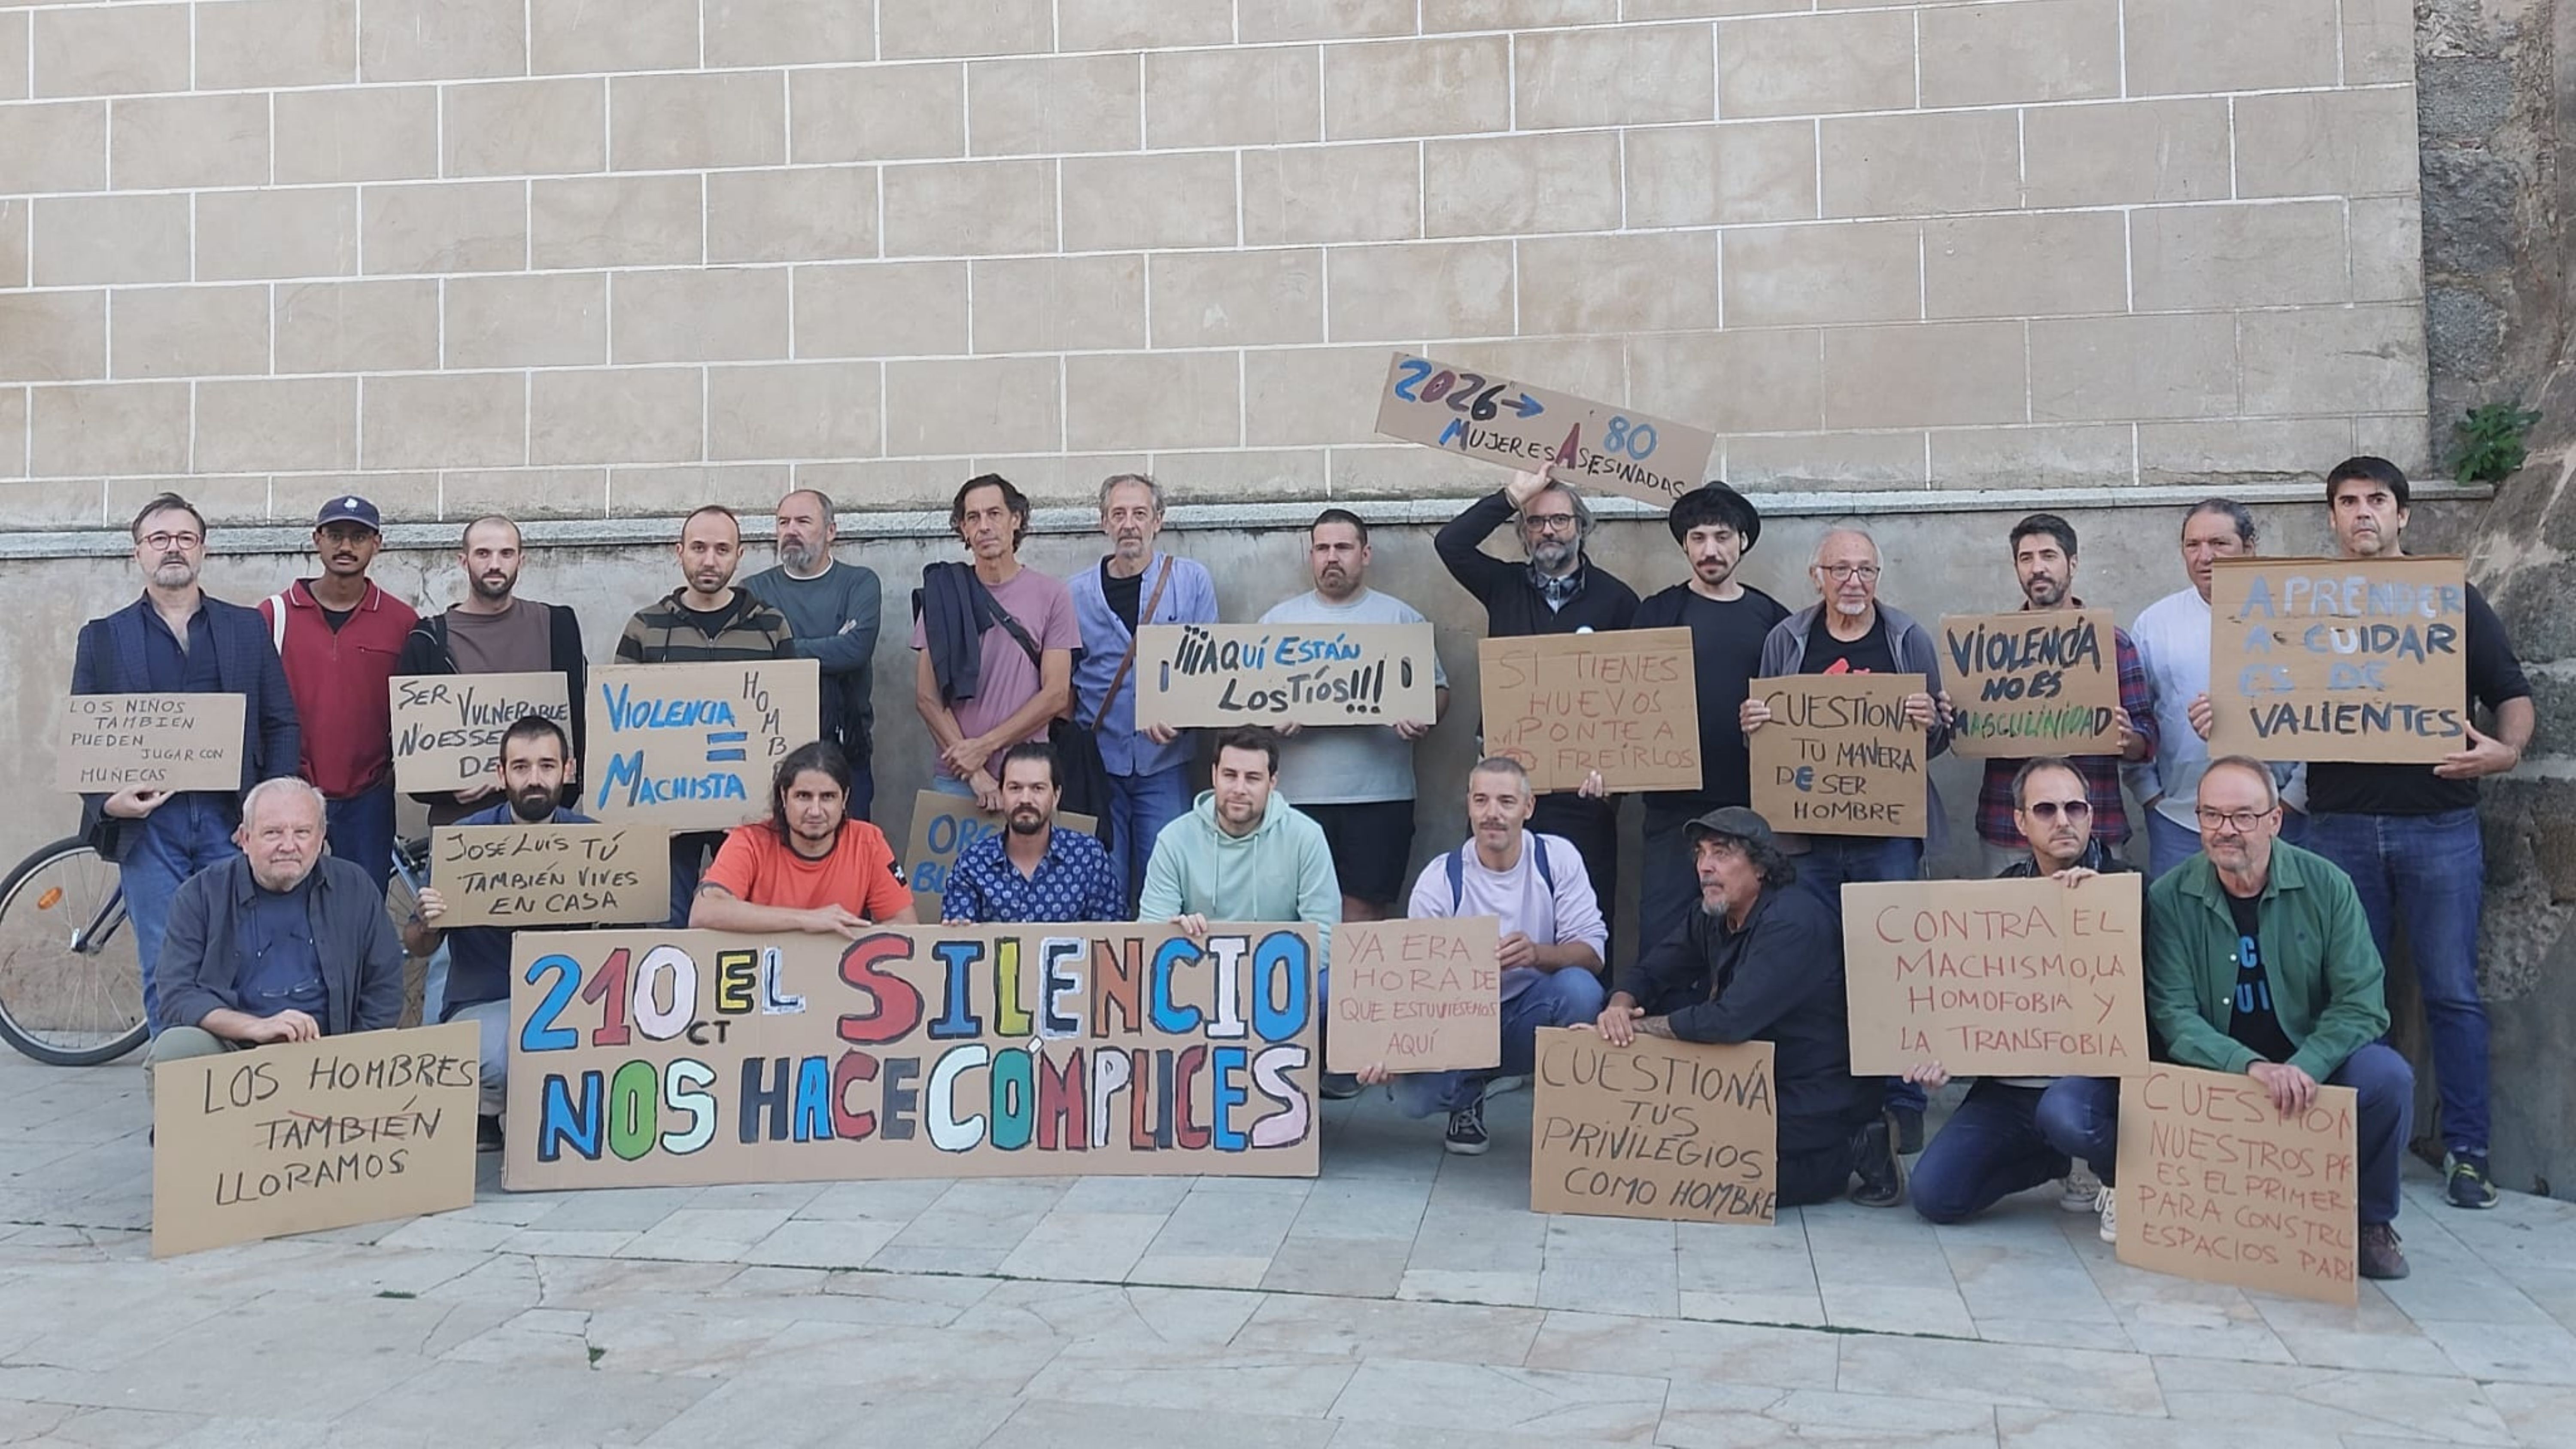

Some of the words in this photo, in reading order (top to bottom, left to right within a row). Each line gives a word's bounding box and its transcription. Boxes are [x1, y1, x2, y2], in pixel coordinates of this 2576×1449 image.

[1395, 360, 1506, 421] 2026
[1601, 416, 1657, 460] 80
[2240, 574, 2464, 619] APRENDER
[1275, 633, 1361, 665] ESTÁN
[2304, 623, 2457, 664] CUIDAR
[1498, 650, 1538, 689] SI
[1562, 651, 1678, 684] TIENES
[1981, 677, 2025, 701] NO
[2027, 670, 2063, 699] ES
[2239, 664, 2294, 697] ES
[2328, 661, 2390, 690] DE
[70, 700, 113, 714] LOS
[125, 699, 186, 714] NIÑOS
[398, 680, 451, 710] SER
[457, 686, 568, 726] VULNERABLE
[602, 683, 735, 732] VIOLENCIA
[1516, 717, 1641, 744] PONTE
[1654, 721, 1674, 740] A
[2250, 700, 2464, 738] VALIENTES
[71, 733, 143, 746] PUEDEN
[141, 748, 193, 761] JUGAR
[200, 748, 223, 759] CON
[1791, 738, 1826, 762] TU
[1837, 736, 1917, 773] MANERA
[80, 767, 167, 783] MUÑECAS
[598, 749, 747, 810] MACHISTA
[1776, 766, 1814, 792] DE
[1818, 775, 1867, 795] SER
[1794, 801, 1905, 825] HOMBRE
[446, 833, 510, 861] JOSÉ
[581, 830, 626, 861] TÚ
[457, 862, 565, 894] TAMBIÉN
[578, 867, 639, 887] VIVES
[489, 897, 535, 915] EN
[546, 890, 618, 912] CASA
[1876, 905, 2057, 943] CONTRA
[2074, 908, 2124, 936] EL
[1346, 930, 1384, 963] YA
[1402, 934, 1471, 961] ERA
[716, 945, 806, 1015] EL
[836, 930, 1311, 1045] SILENCIO
[1353, 967, 1461, 991] HORA
[1471, 968, 1497, 990] DE
[1339, 998, 1386, 1022] QUE
[1909, 985, 2072, 1014] HOMOFOBIA
[2093, 992, 2115, 1024] Y
[1386, 1028, 1439, 1057] AQUÍ
[1901, 1026, 1931, 1054] LA
[1947, 1024, 2128, 1057] TRANSFOBIA
[205, 1063, 279, 1114] LOS
[310, 1053, 476, 1091] HOMBRES
[538, 1058, 717, 1162] NOS
[739, 1047, 920, 1143] HACE
[925, 1035, 1311, 1153] CÓMPLICES
[255, 1095, 441, 1150] TAMBIÉN
[1621, 1100, 1699, 1138] TUS
[1541, 1117, 1762, 1179] PRIVILEGIOS
[2150, 1120, 2314, 1177] NUESTROS
[216, 1149, 408, 1206] LLORAMOS
[1564, 1166, 1657, 1205] COMO
[1669, 1179, 1776, 1219] HOMBRE
[2157, 1162, 2190, 1187] ES
[2205, 1171, 2237, 1196] EL
[2245, 1176, 2348, 1211] PRIMER
[2138, 1185, 2222, 1223] PARA
[2142, 1224, 2279, 1264] ESPACIOS
